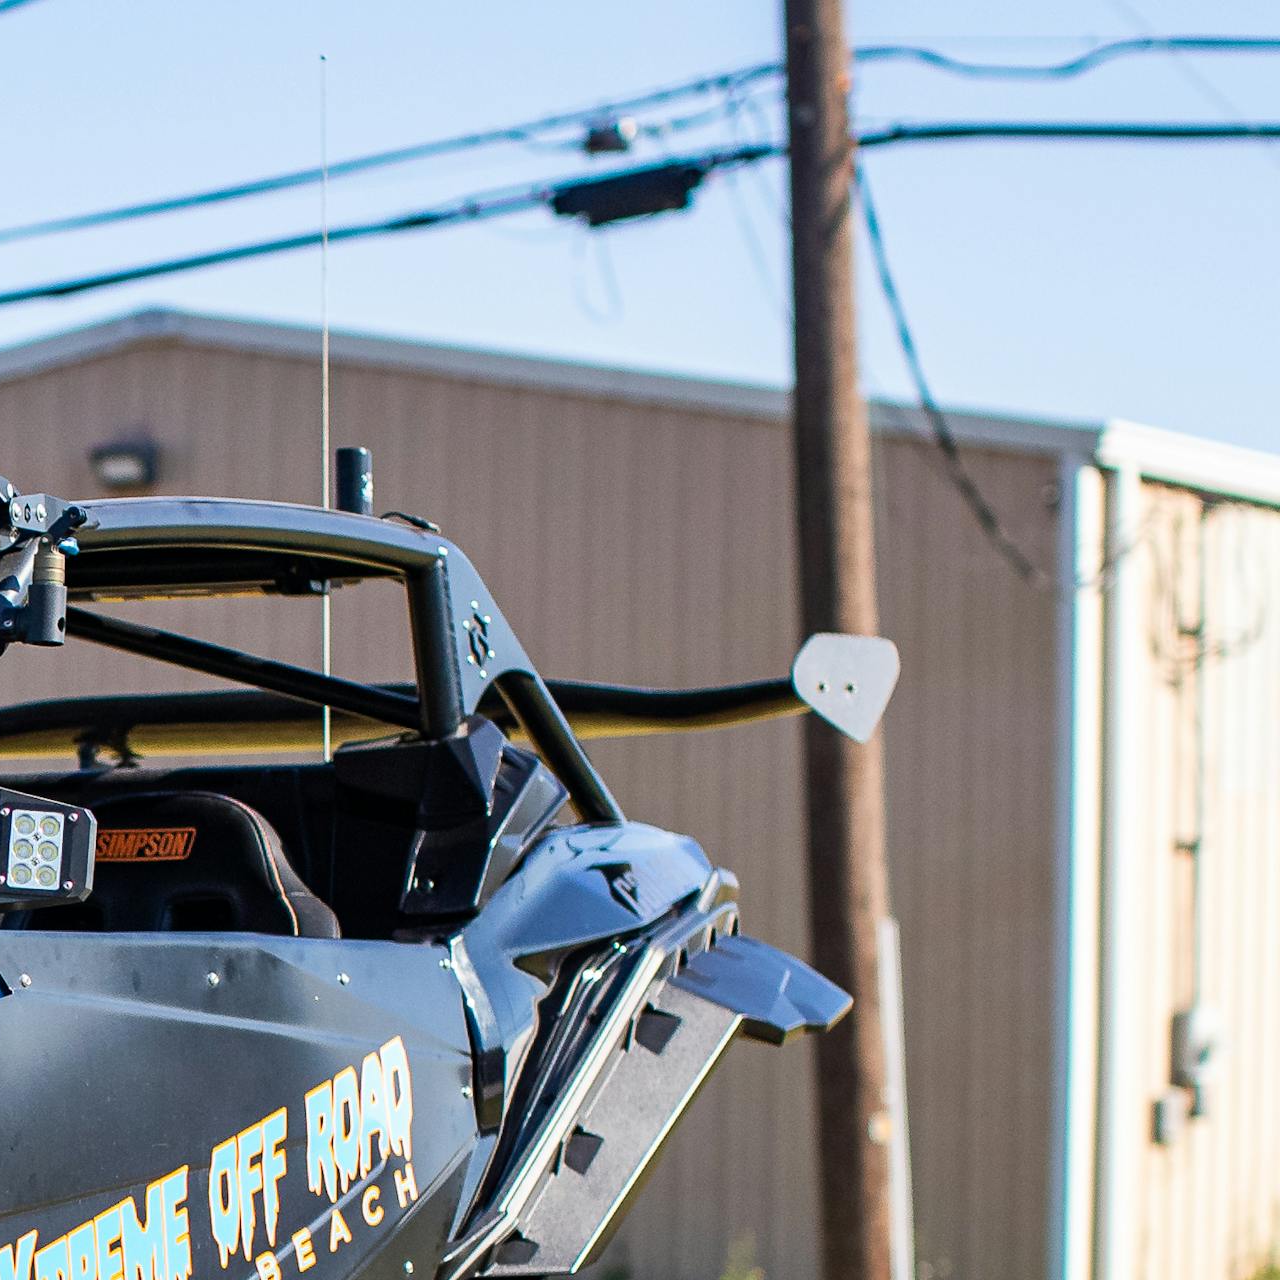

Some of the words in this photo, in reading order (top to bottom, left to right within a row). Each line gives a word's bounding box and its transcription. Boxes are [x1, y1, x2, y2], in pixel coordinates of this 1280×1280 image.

[97, 832, 188, 856] SIMPSON
[208, 1107, 288, 1269] OFF
[304, 1036, 414, 1203] ROAD
